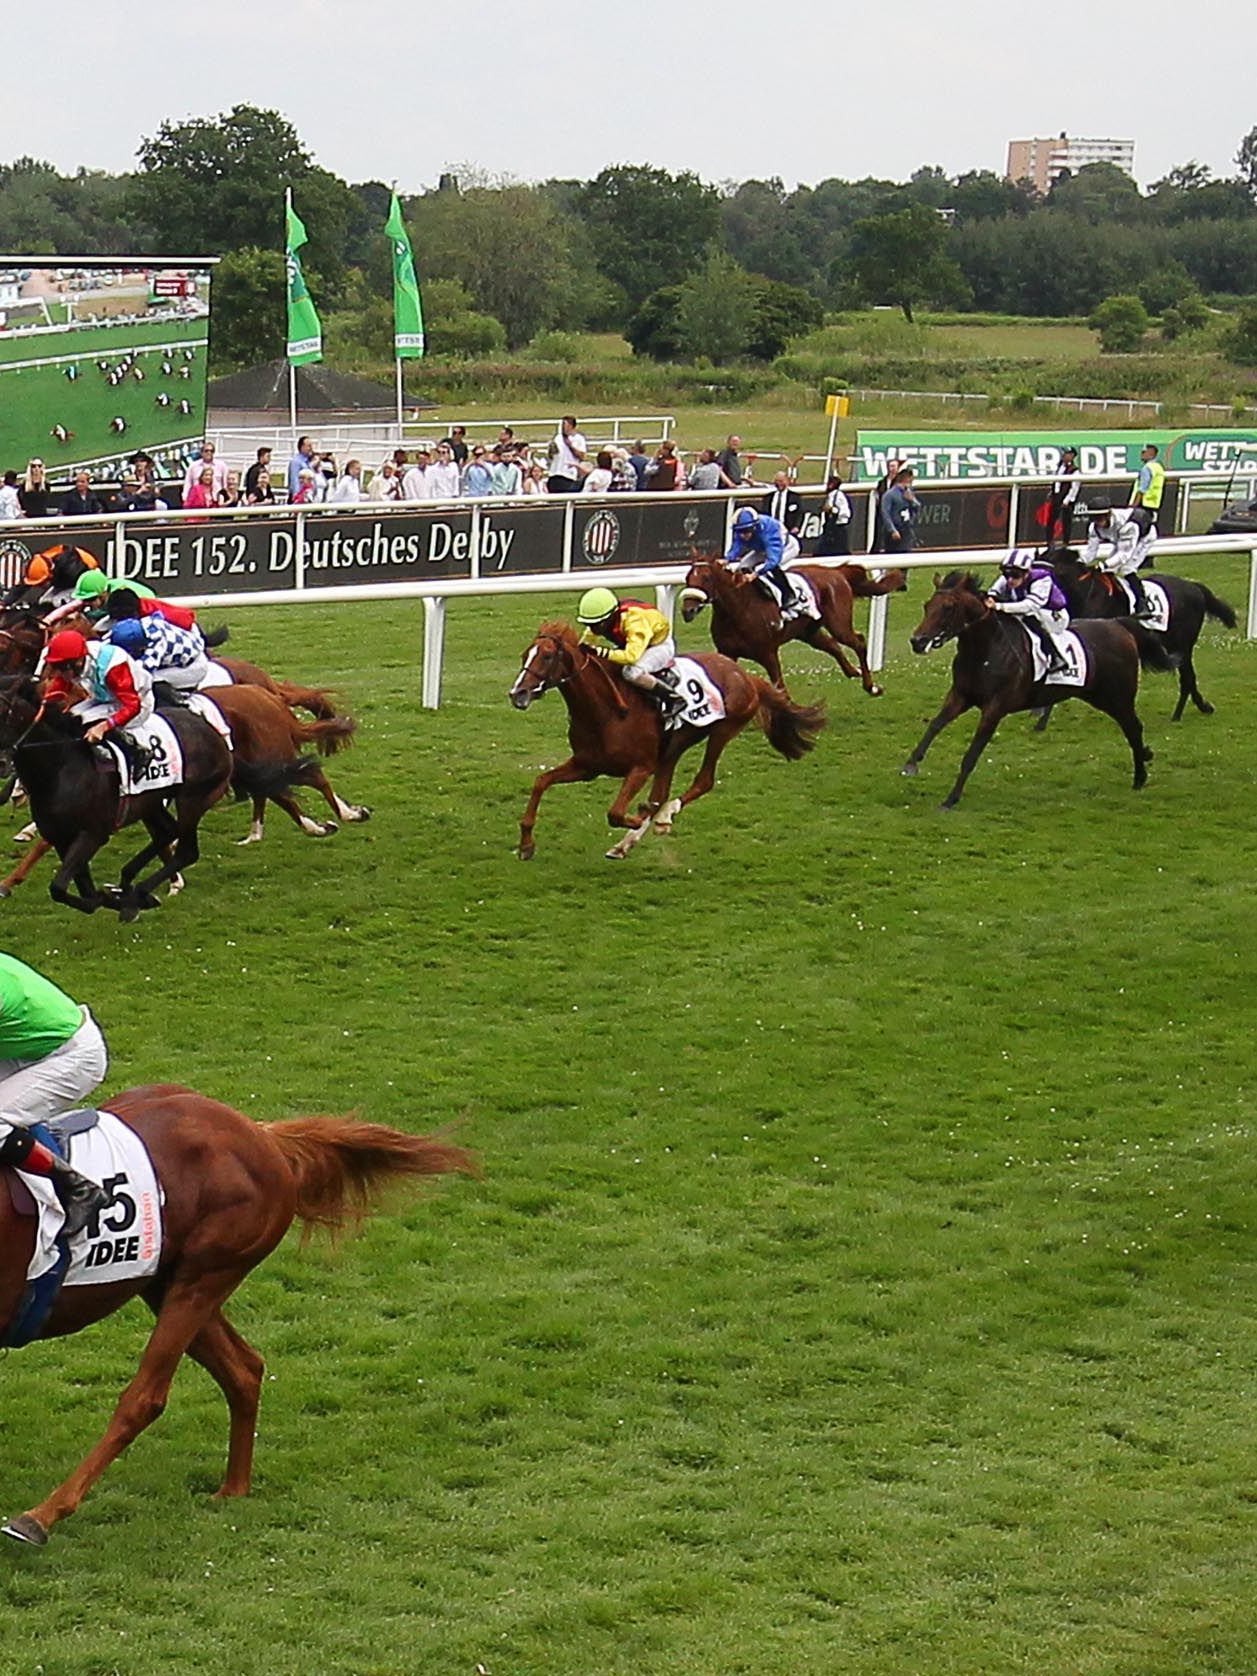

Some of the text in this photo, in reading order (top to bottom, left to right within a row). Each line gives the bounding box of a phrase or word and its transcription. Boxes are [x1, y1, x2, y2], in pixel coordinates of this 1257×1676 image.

[862, 446, 1127, 477] WETTSTARDE
[106, 516, 515, 583] IDEE 152. Deutsches Deby
[687, 678, 704, 704] 9
[149, 735, 167, 762] 8
[84, 1236, 140, 1269] IDEE
